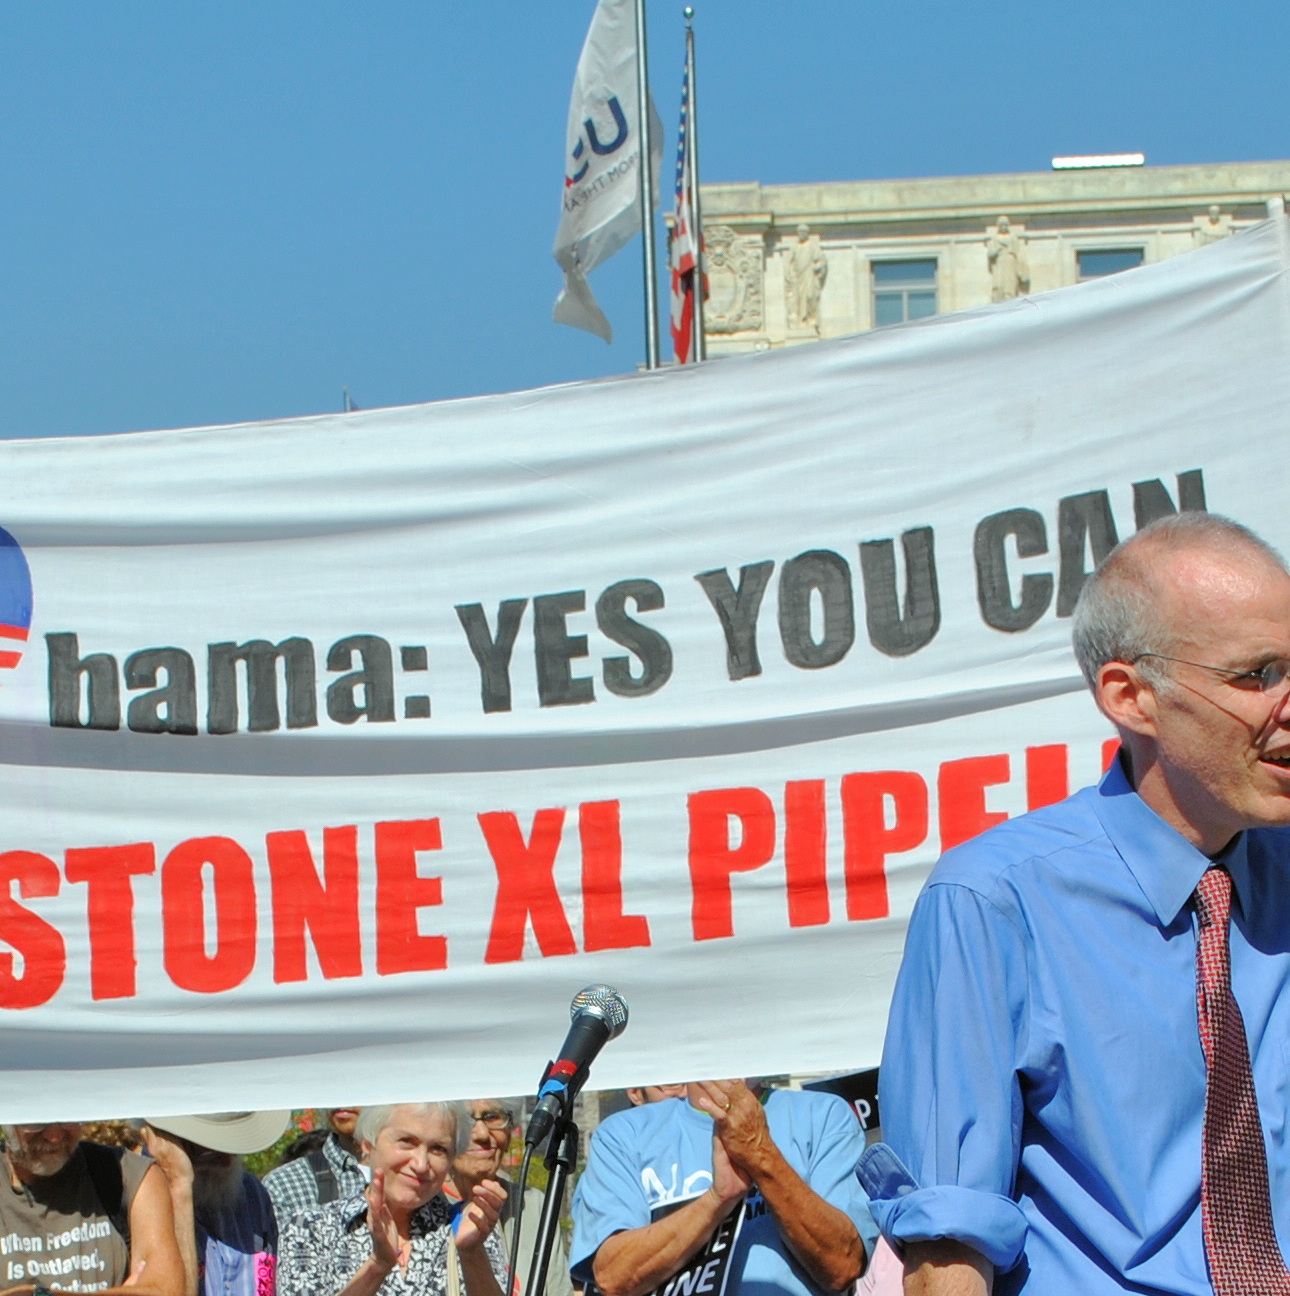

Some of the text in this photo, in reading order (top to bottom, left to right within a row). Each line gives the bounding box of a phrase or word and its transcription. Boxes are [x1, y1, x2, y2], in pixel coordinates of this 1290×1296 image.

[455, 578, 673, 713] YES
[694, 525, 941, 681] YOU
[478, 799, 650, 964] XL
[0, 1220, 111, 1255] When Freedom
[7, 1261, 25, 1280] Is
